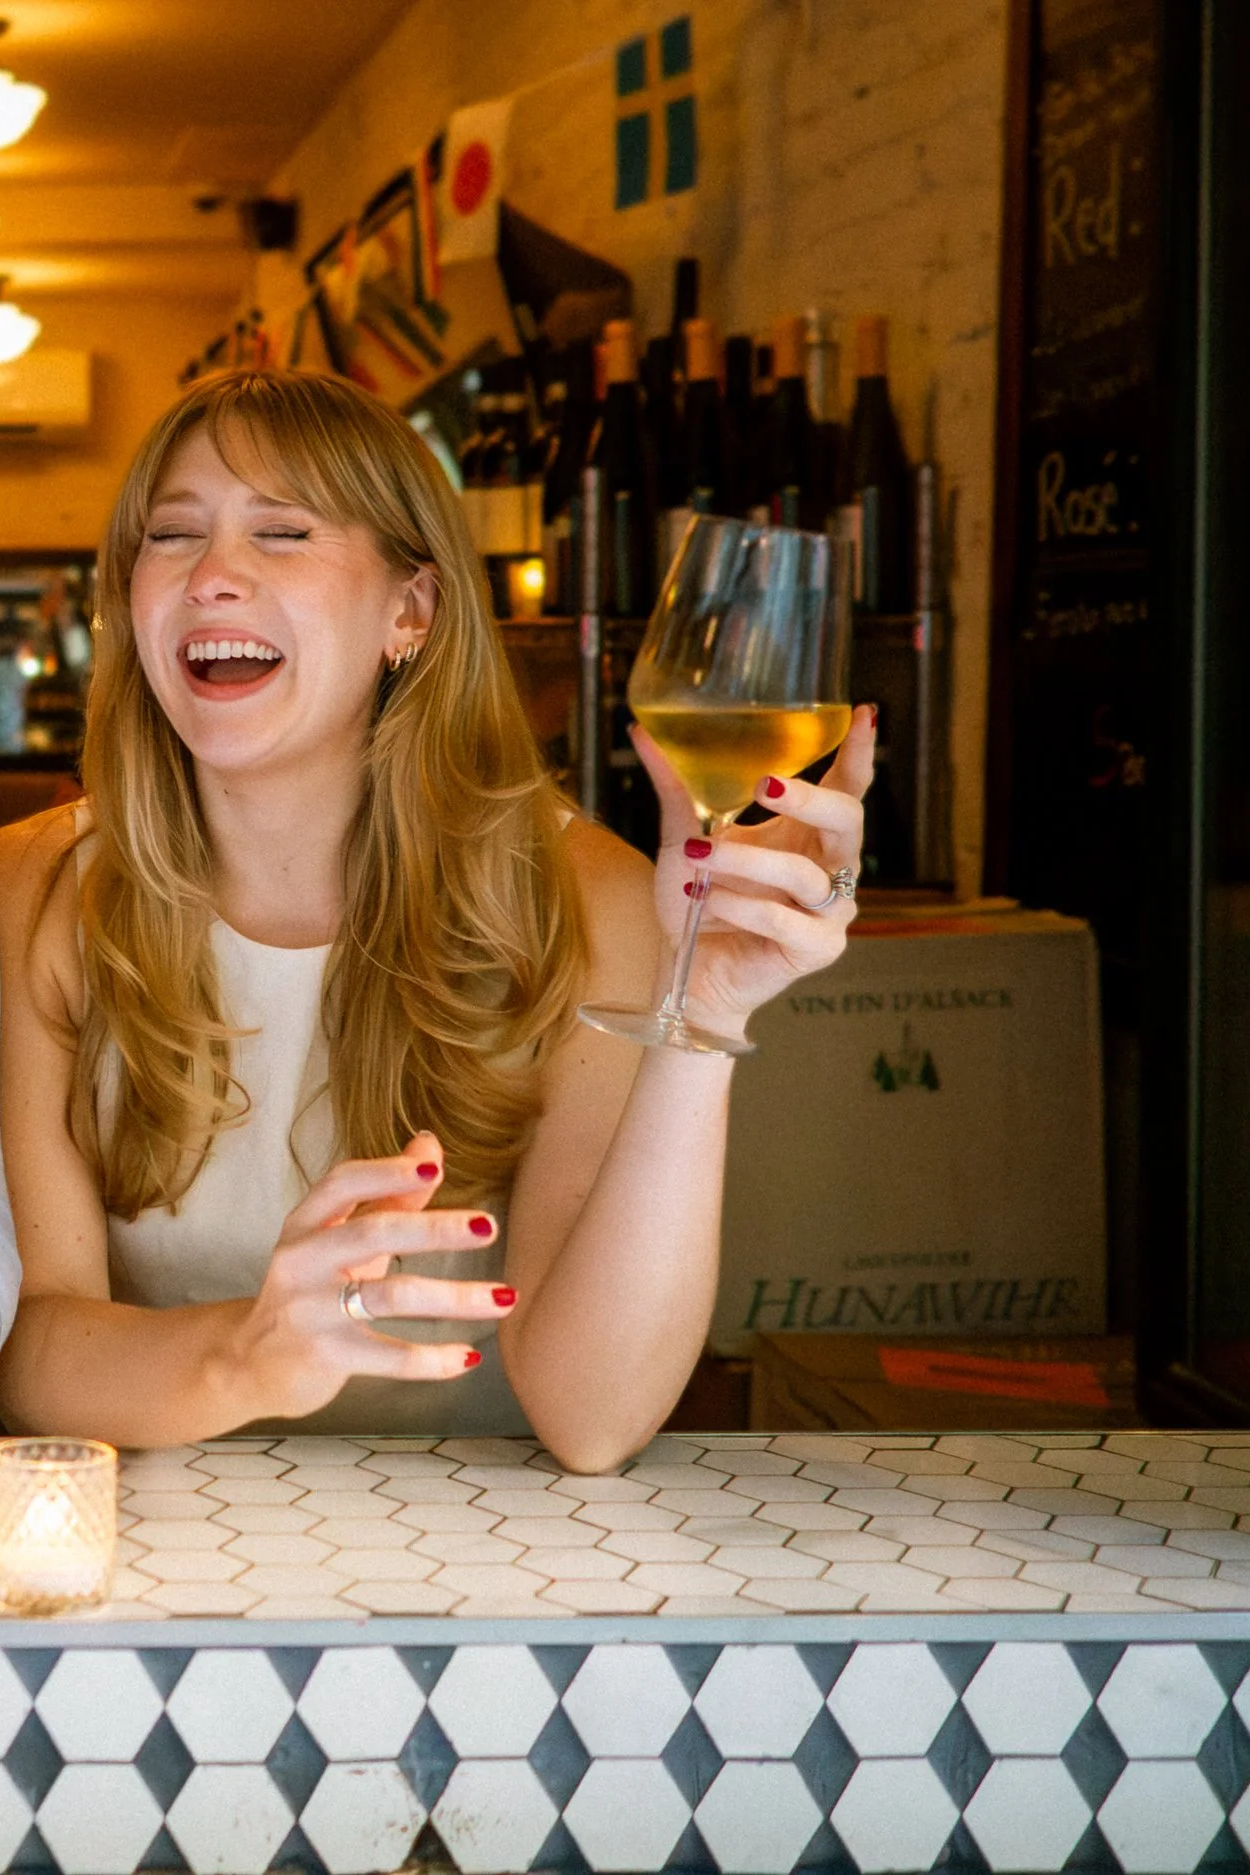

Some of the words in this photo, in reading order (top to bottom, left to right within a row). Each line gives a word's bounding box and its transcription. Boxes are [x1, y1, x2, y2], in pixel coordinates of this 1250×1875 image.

[787, 994, 837, 1015] VIN
[841, 992, 884, 1014] FIN
[890, 988, 1013, 1012] D'ALSACE
